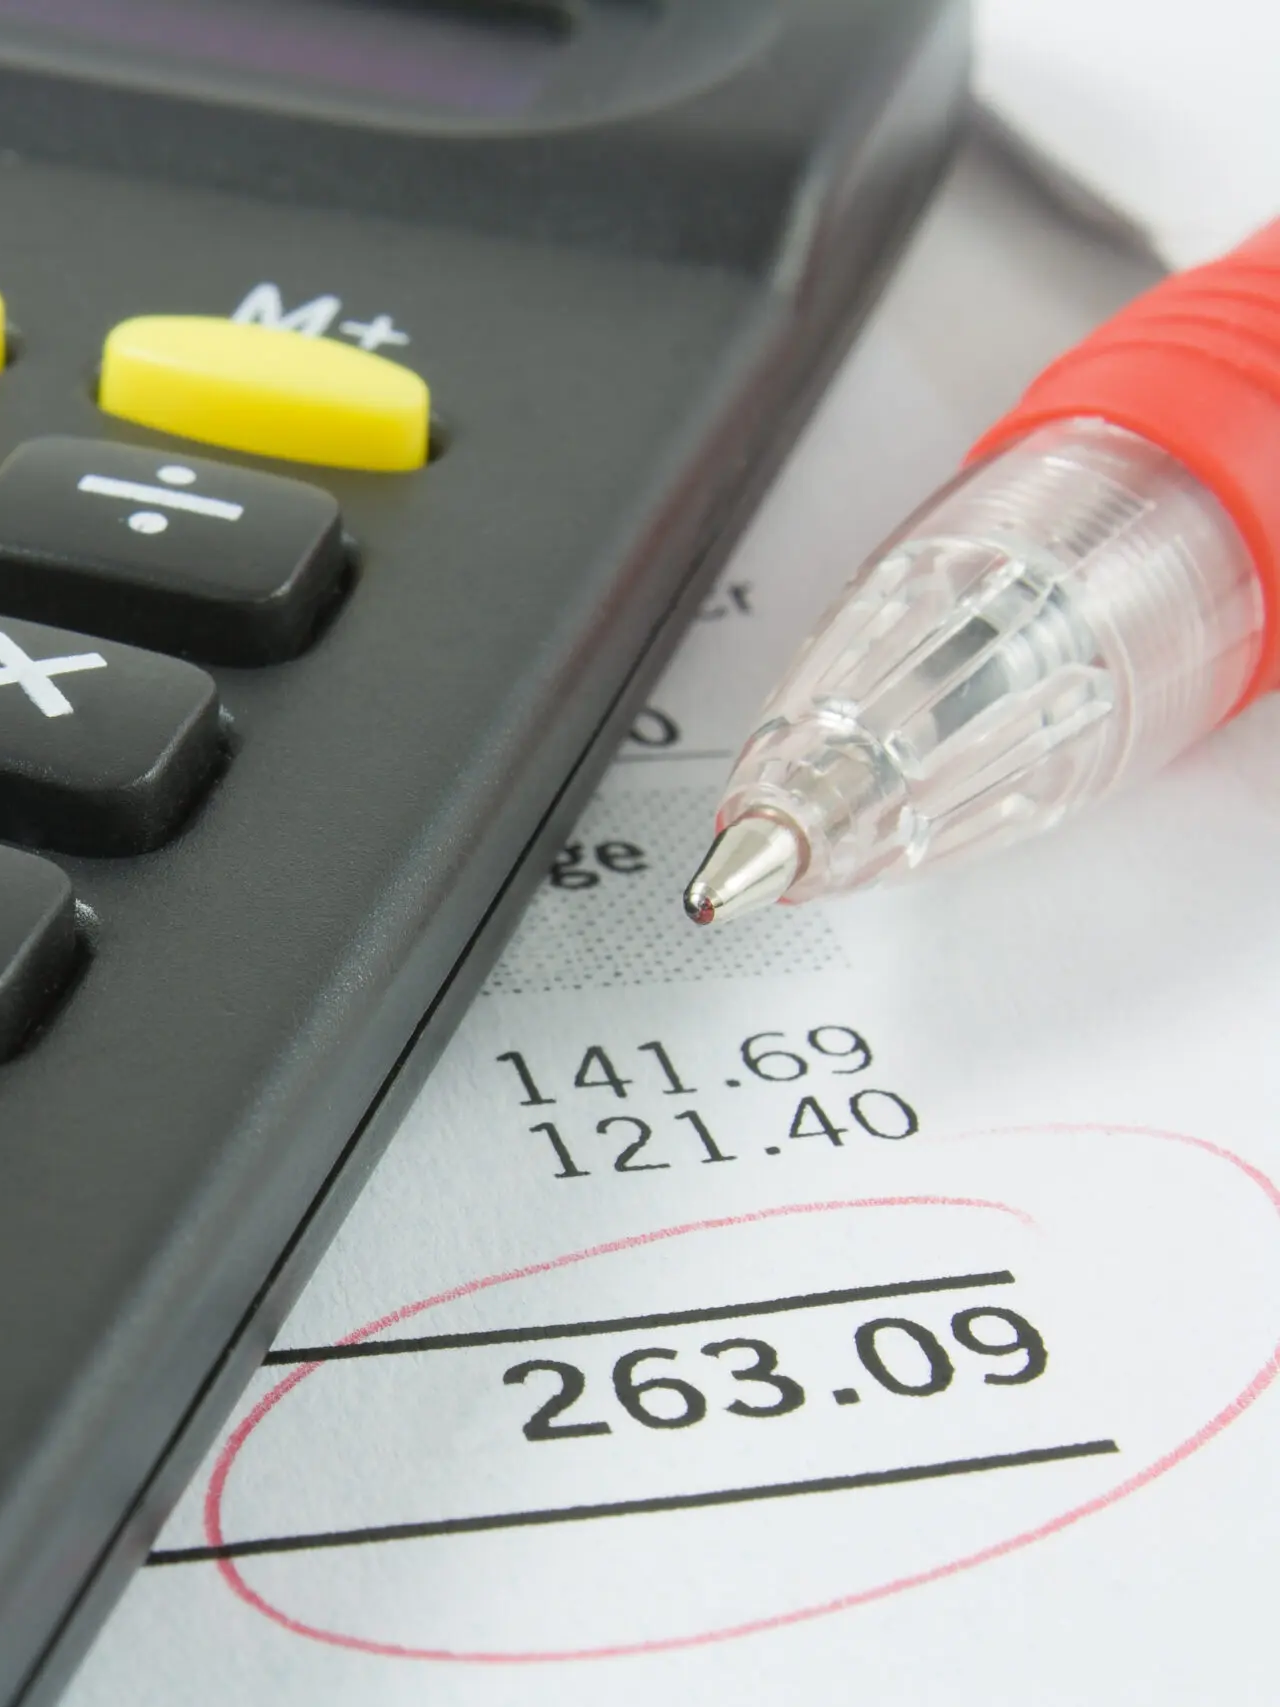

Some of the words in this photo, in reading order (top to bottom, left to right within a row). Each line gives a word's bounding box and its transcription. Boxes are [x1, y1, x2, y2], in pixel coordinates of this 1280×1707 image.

[230, 280, 410, 350] M+
[496, 1024, 875, 1107] 141.69
[528, 1087, 920, 1179] 121.40
[502, 1306, 1049, 1442] 263.09
